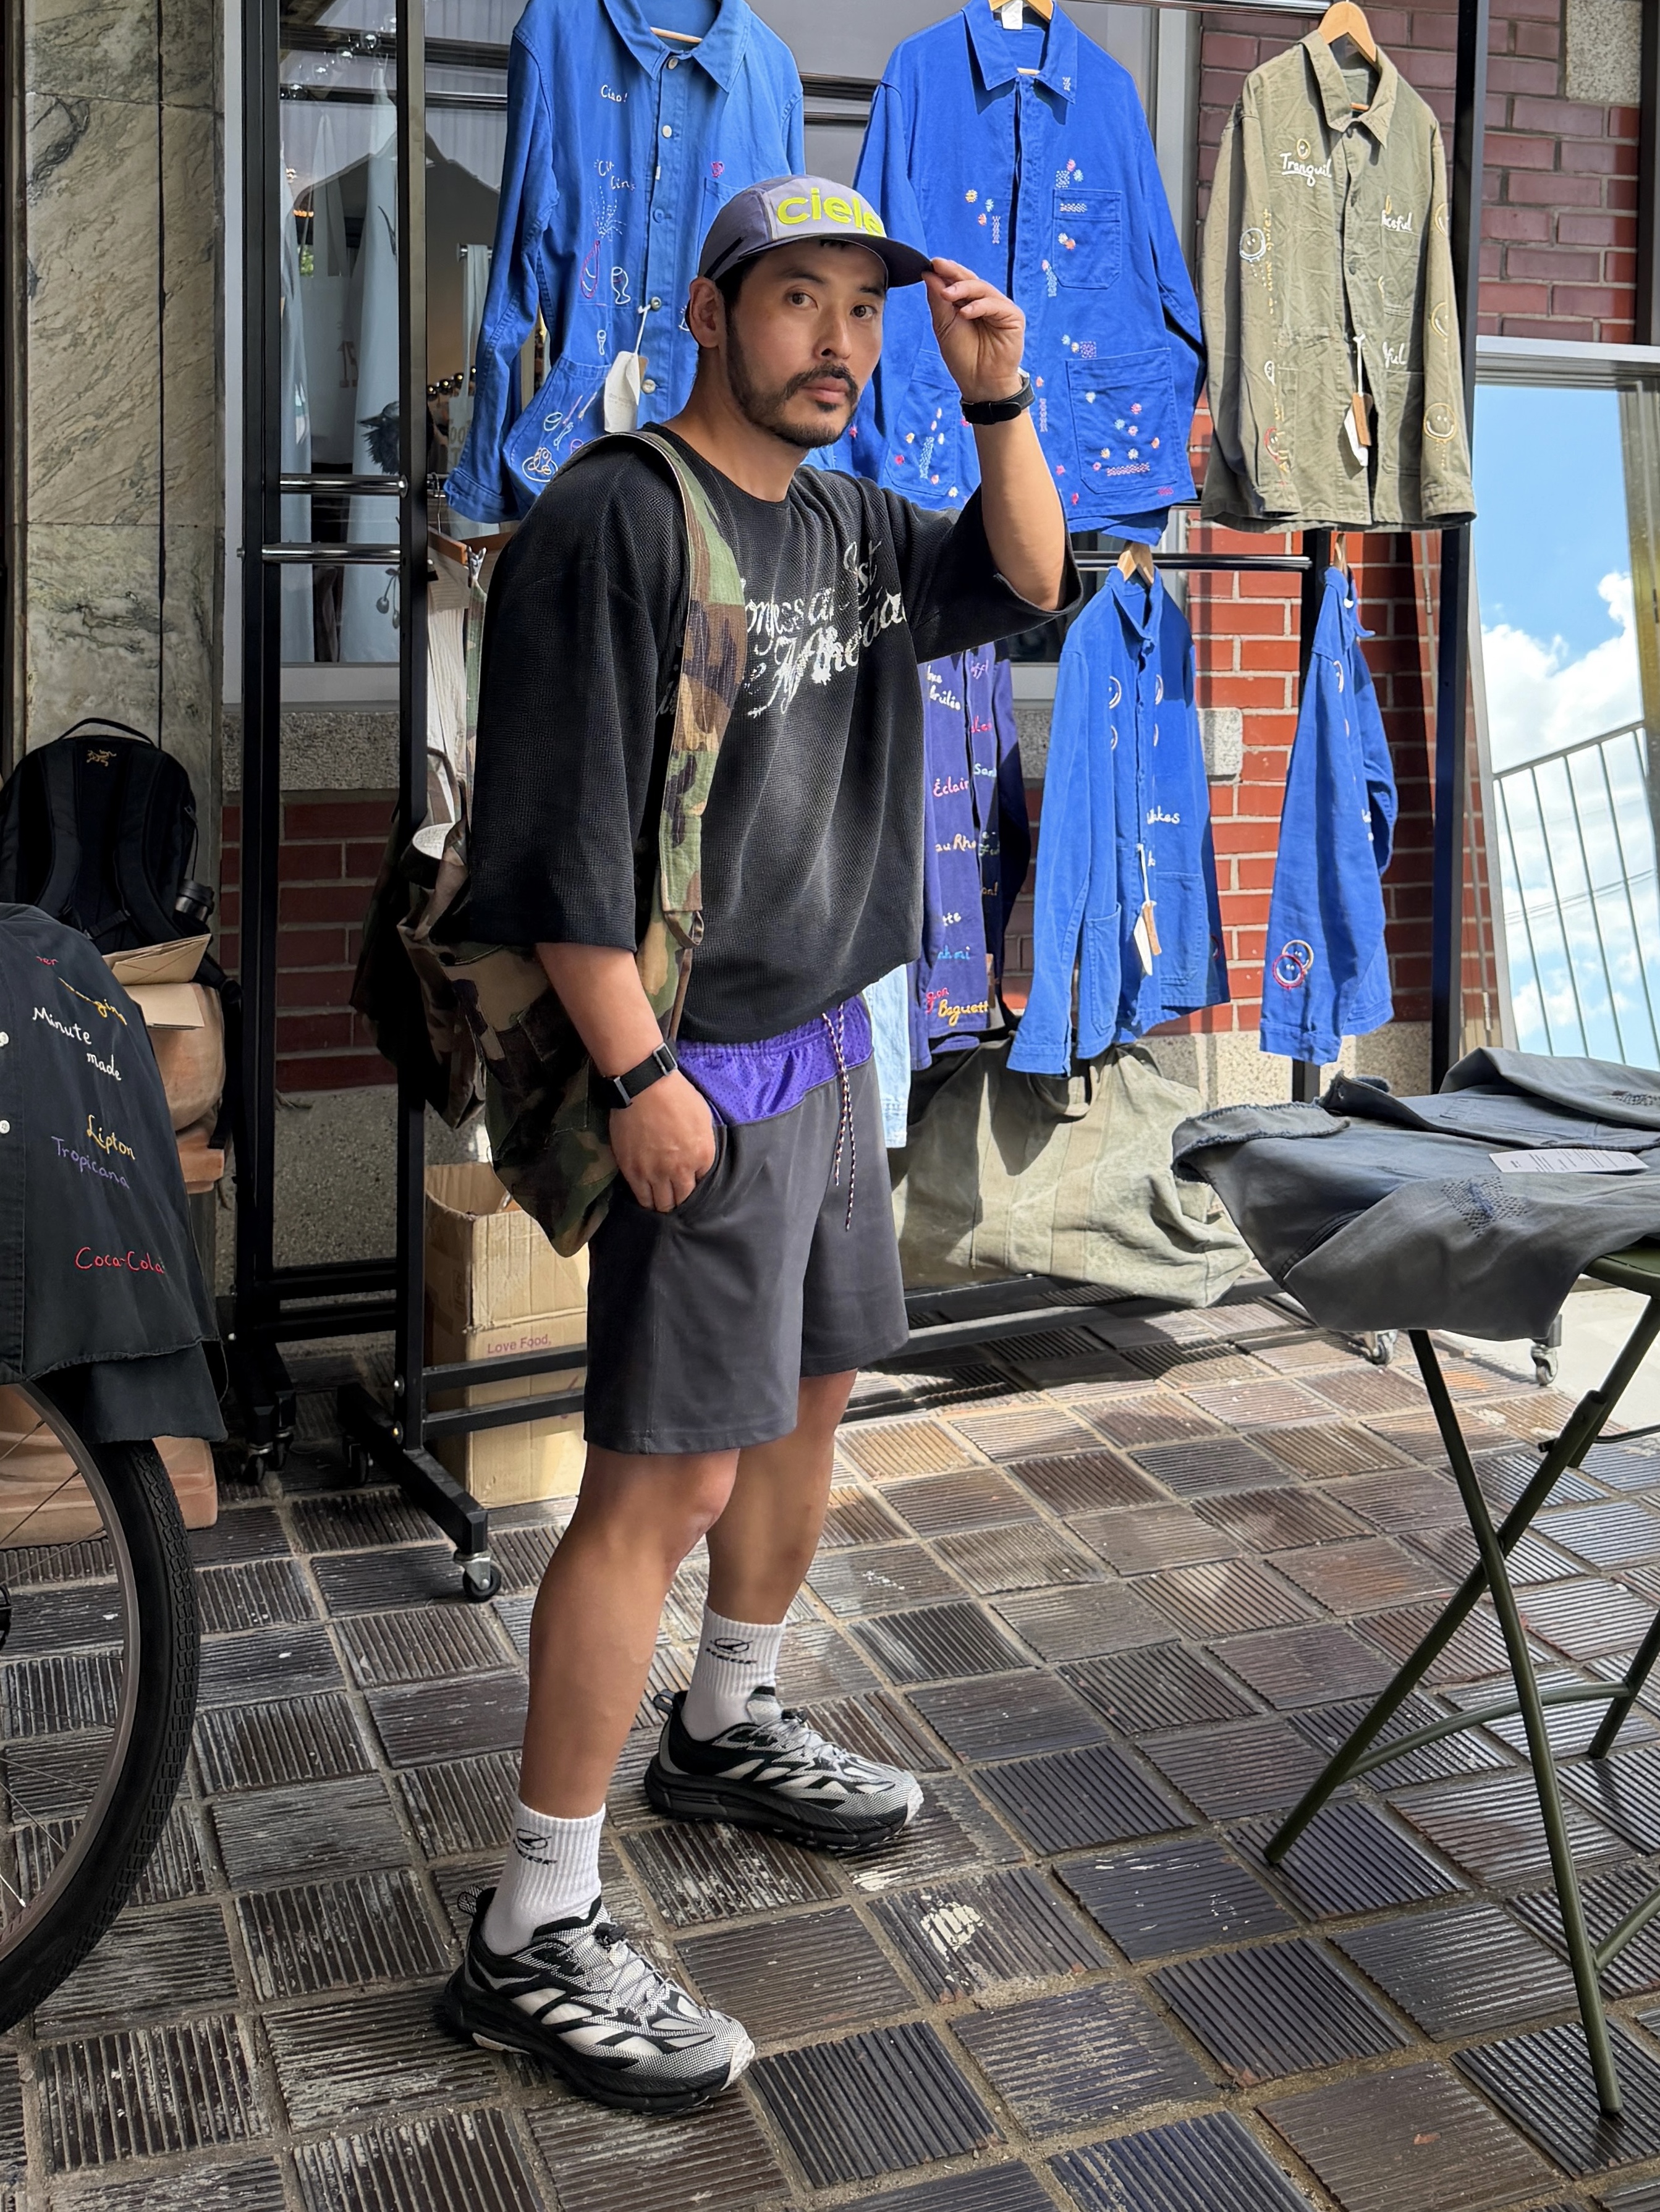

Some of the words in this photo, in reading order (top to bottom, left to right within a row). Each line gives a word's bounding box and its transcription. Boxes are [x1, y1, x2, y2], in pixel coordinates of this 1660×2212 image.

[601, 85, 628, 103] Ciao!
[1279, 152, 1332, 187] Tranquil
[32, 1007, 92, 1045] Minute
[87, 1053, 122, 1081] made
[87, 1114, 135, 1161] Lipton
[51, 1136, 130, 1189] Tropicana
[74, 1246, 166, 1274] Coca-Cola
[487, 1341, 517, 1354] Love
[520, 1333, 552, 1349] Food,
